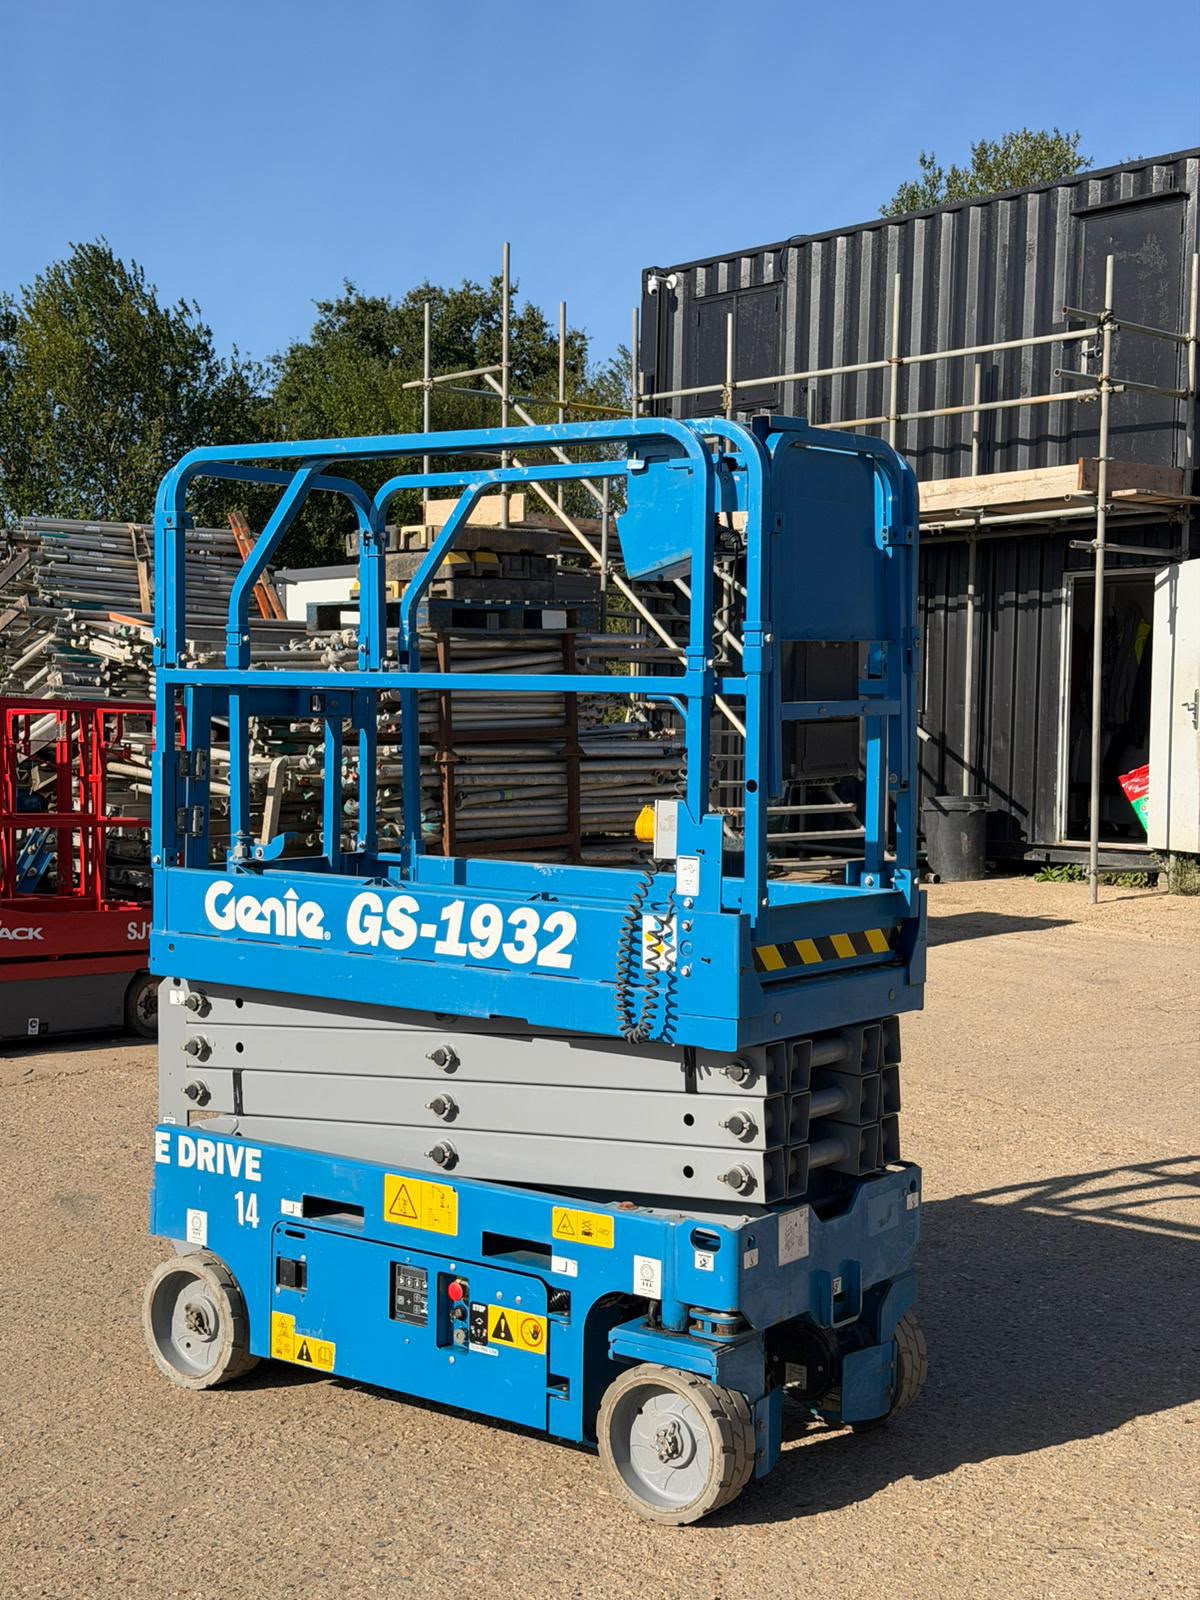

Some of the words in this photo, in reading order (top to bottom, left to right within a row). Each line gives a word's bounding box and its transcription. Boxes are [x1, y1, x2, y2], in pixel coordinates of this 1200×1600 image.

[204, 880, 325, 940] Genie
[346, 892, 577, 969] GS-1932
[155, 1131, 171, 1164] E
[178, 1135, 262, 1182] DRIVE
[234, 1191, 260, 1229] 14
